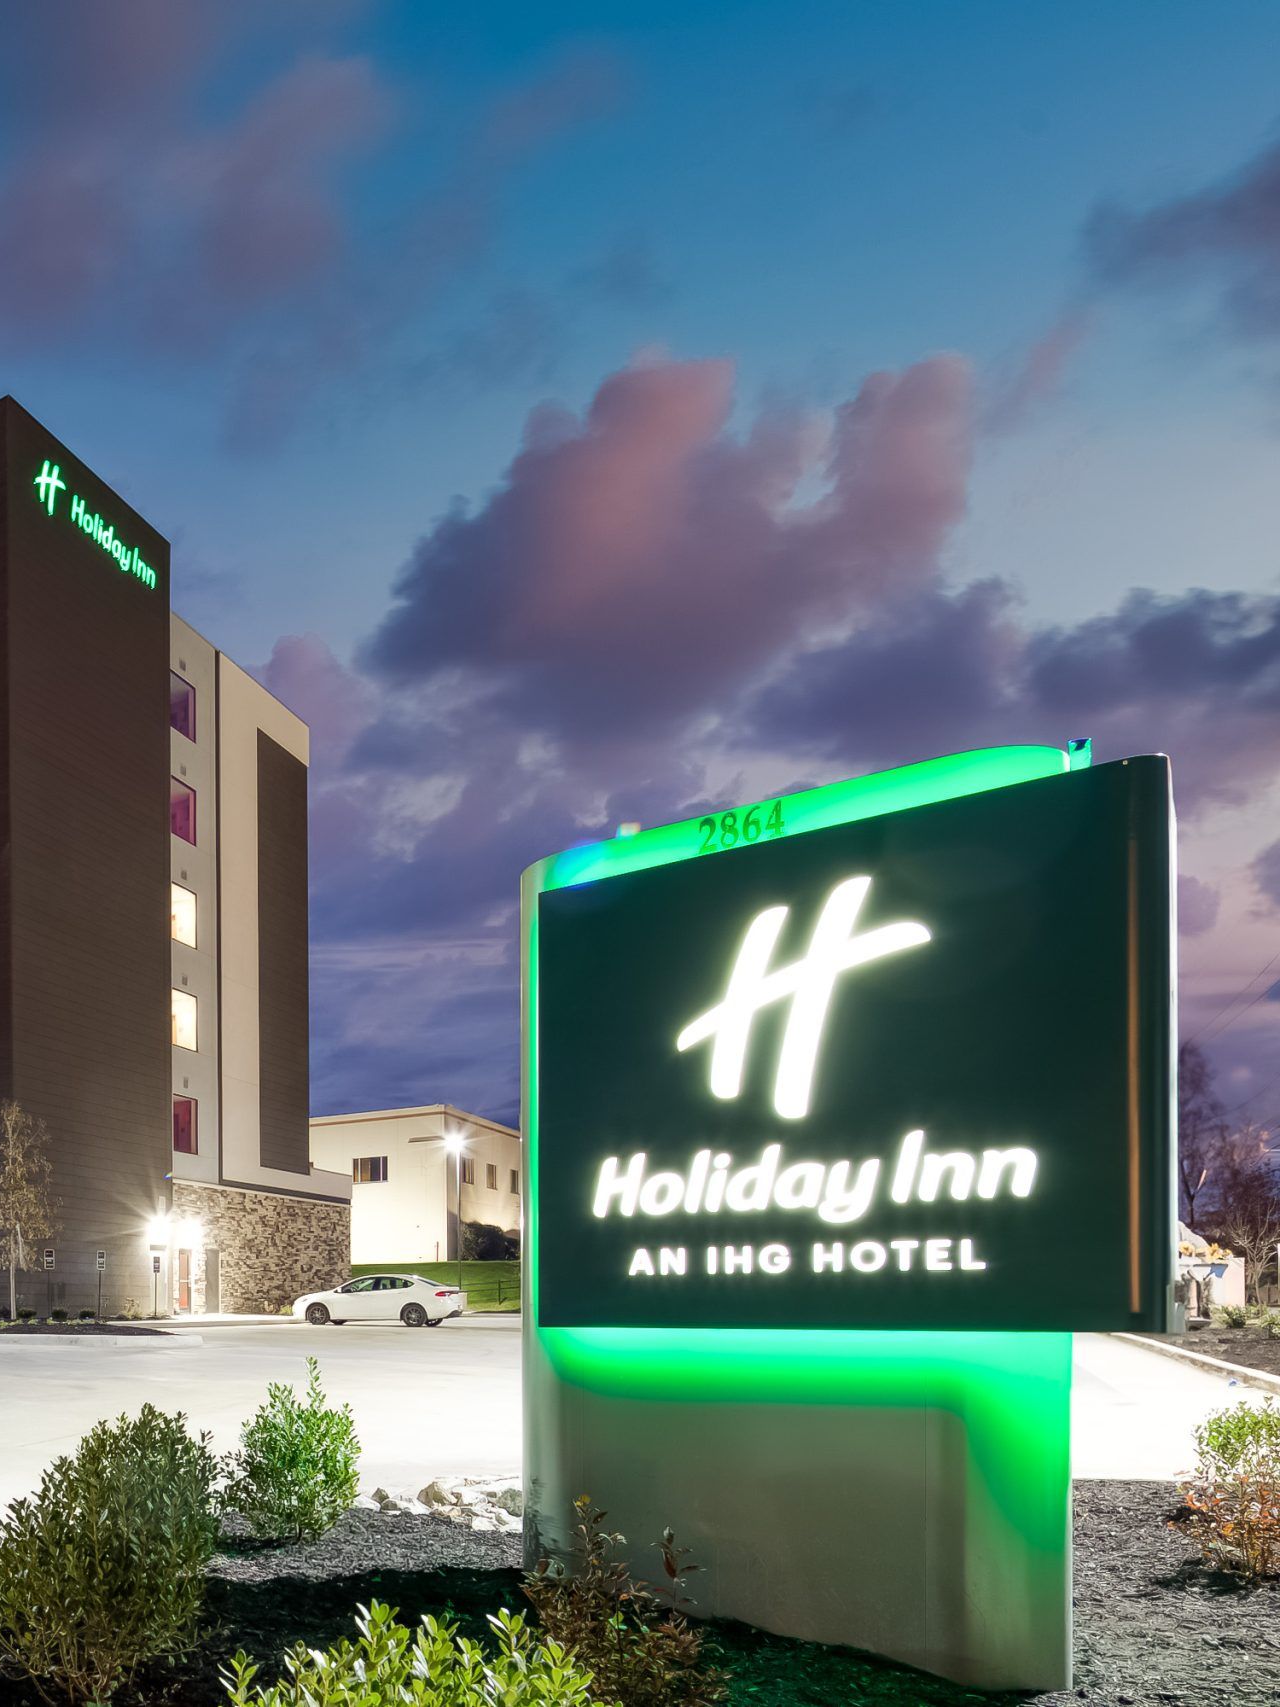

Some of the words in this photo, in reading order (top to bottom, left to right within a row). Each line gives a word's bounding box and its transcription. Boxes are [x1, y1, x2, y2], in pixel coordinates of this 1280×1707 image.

[71, 494, 131, 571] Holiday
[132, 547, 156, 590] Inn
[699, 799, 785, 855] 2864
[591, 1143, 880, 1224] Holiday
[889, 1129, 1038, 1204] Inn
[628, 1246, 686, 1276] AN
[706, 1243, 791, 1274] IHG
[812, 1238, 986, 1273] HOTEL
